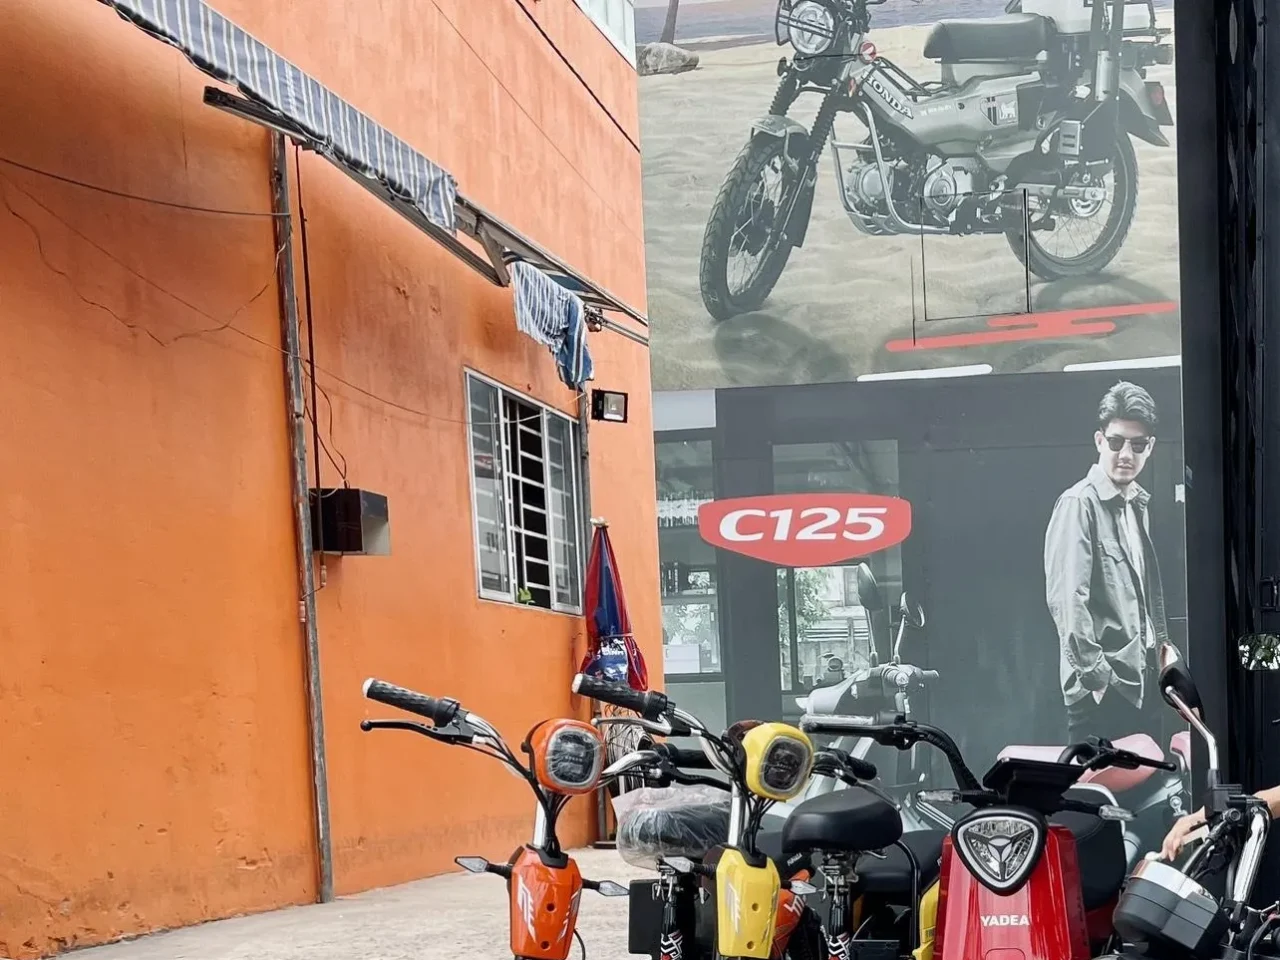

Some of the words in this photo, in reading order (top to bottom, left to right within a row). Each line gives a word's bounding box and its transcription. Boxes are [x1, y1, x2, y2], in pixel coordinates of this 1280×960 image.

[862, 70, 914, 119] HONDA
[719, 507, 888, 542] C125
[980, 914, 1030, 927] YADEA
